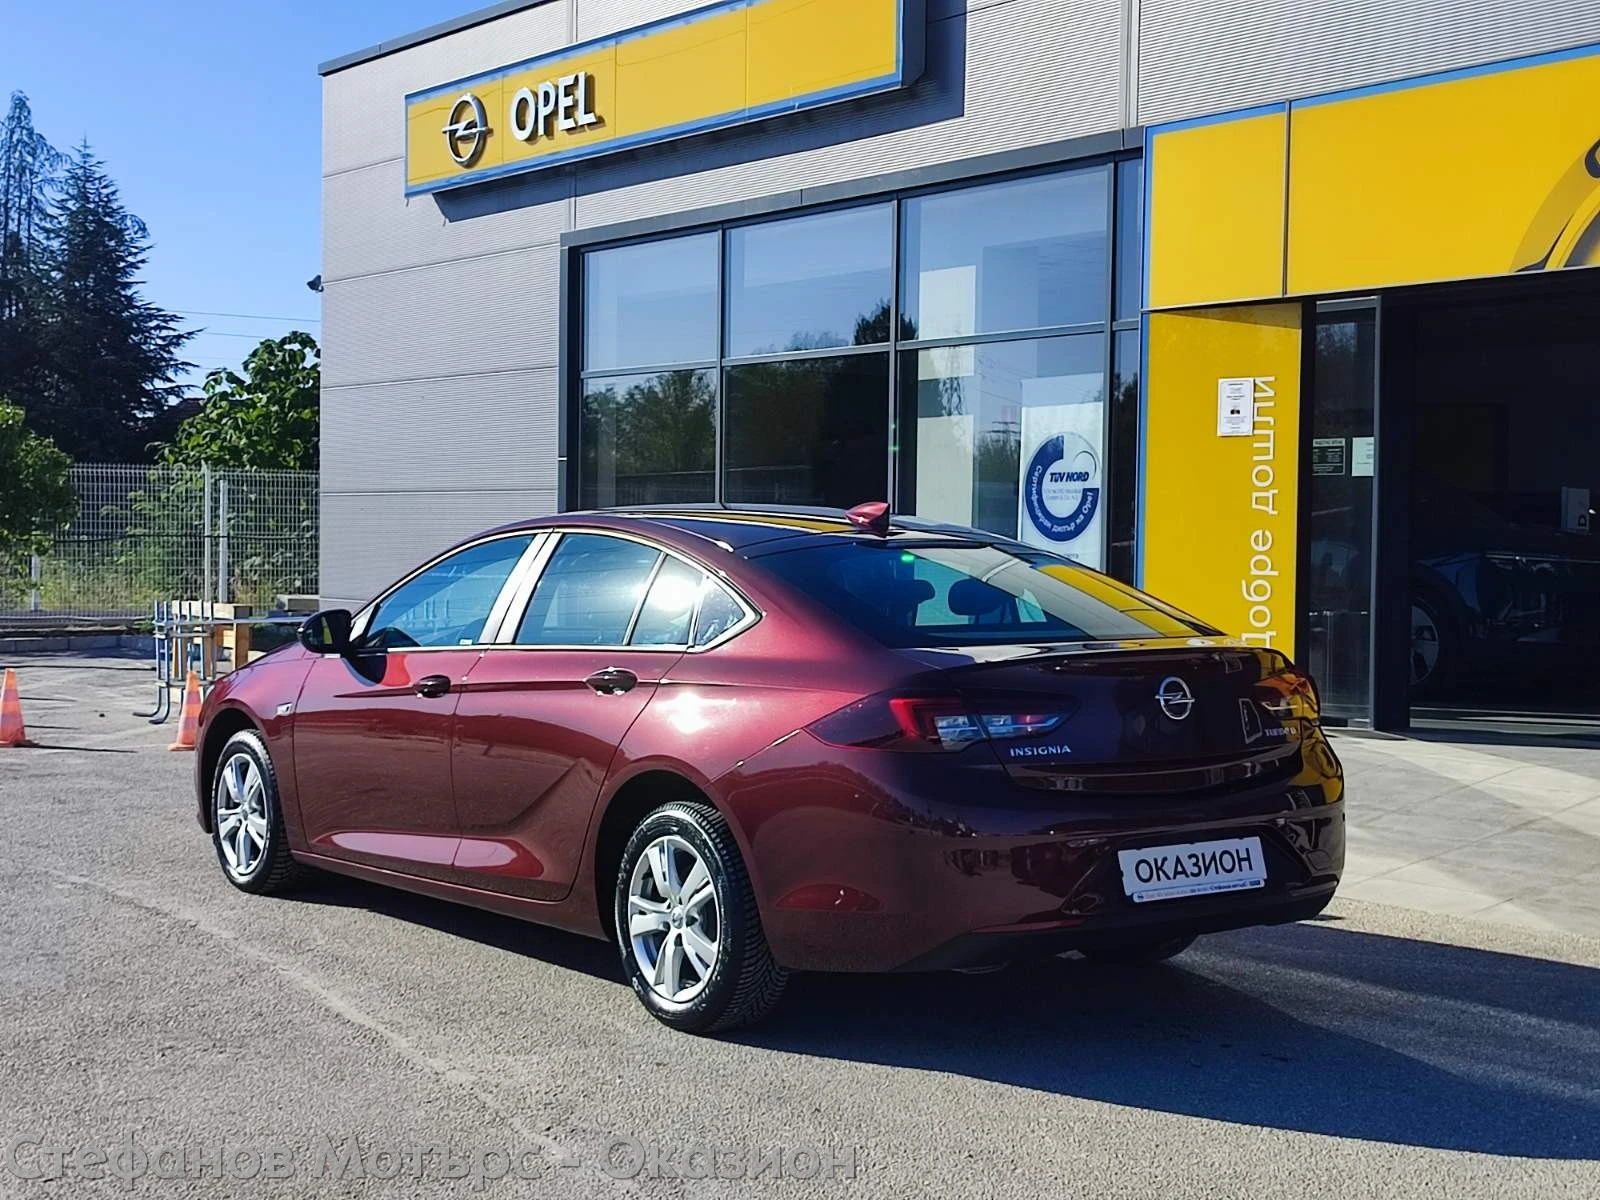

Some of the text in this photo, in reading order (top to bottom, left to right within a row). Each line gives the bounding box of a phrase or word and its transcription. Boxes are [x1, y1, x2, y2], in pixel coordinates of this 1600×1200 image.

[510, 71, 598, 142] OPEL
[1252, 376, 1278, 515] дошли
[1050, 472, 1089, 482] TÜV NORD
[1082, 492, 1093, 513] Opel
[1009, 744, 1072, 757] INSIGNIA
[1134, 847, 1254, 884] ОКАЗИОН
